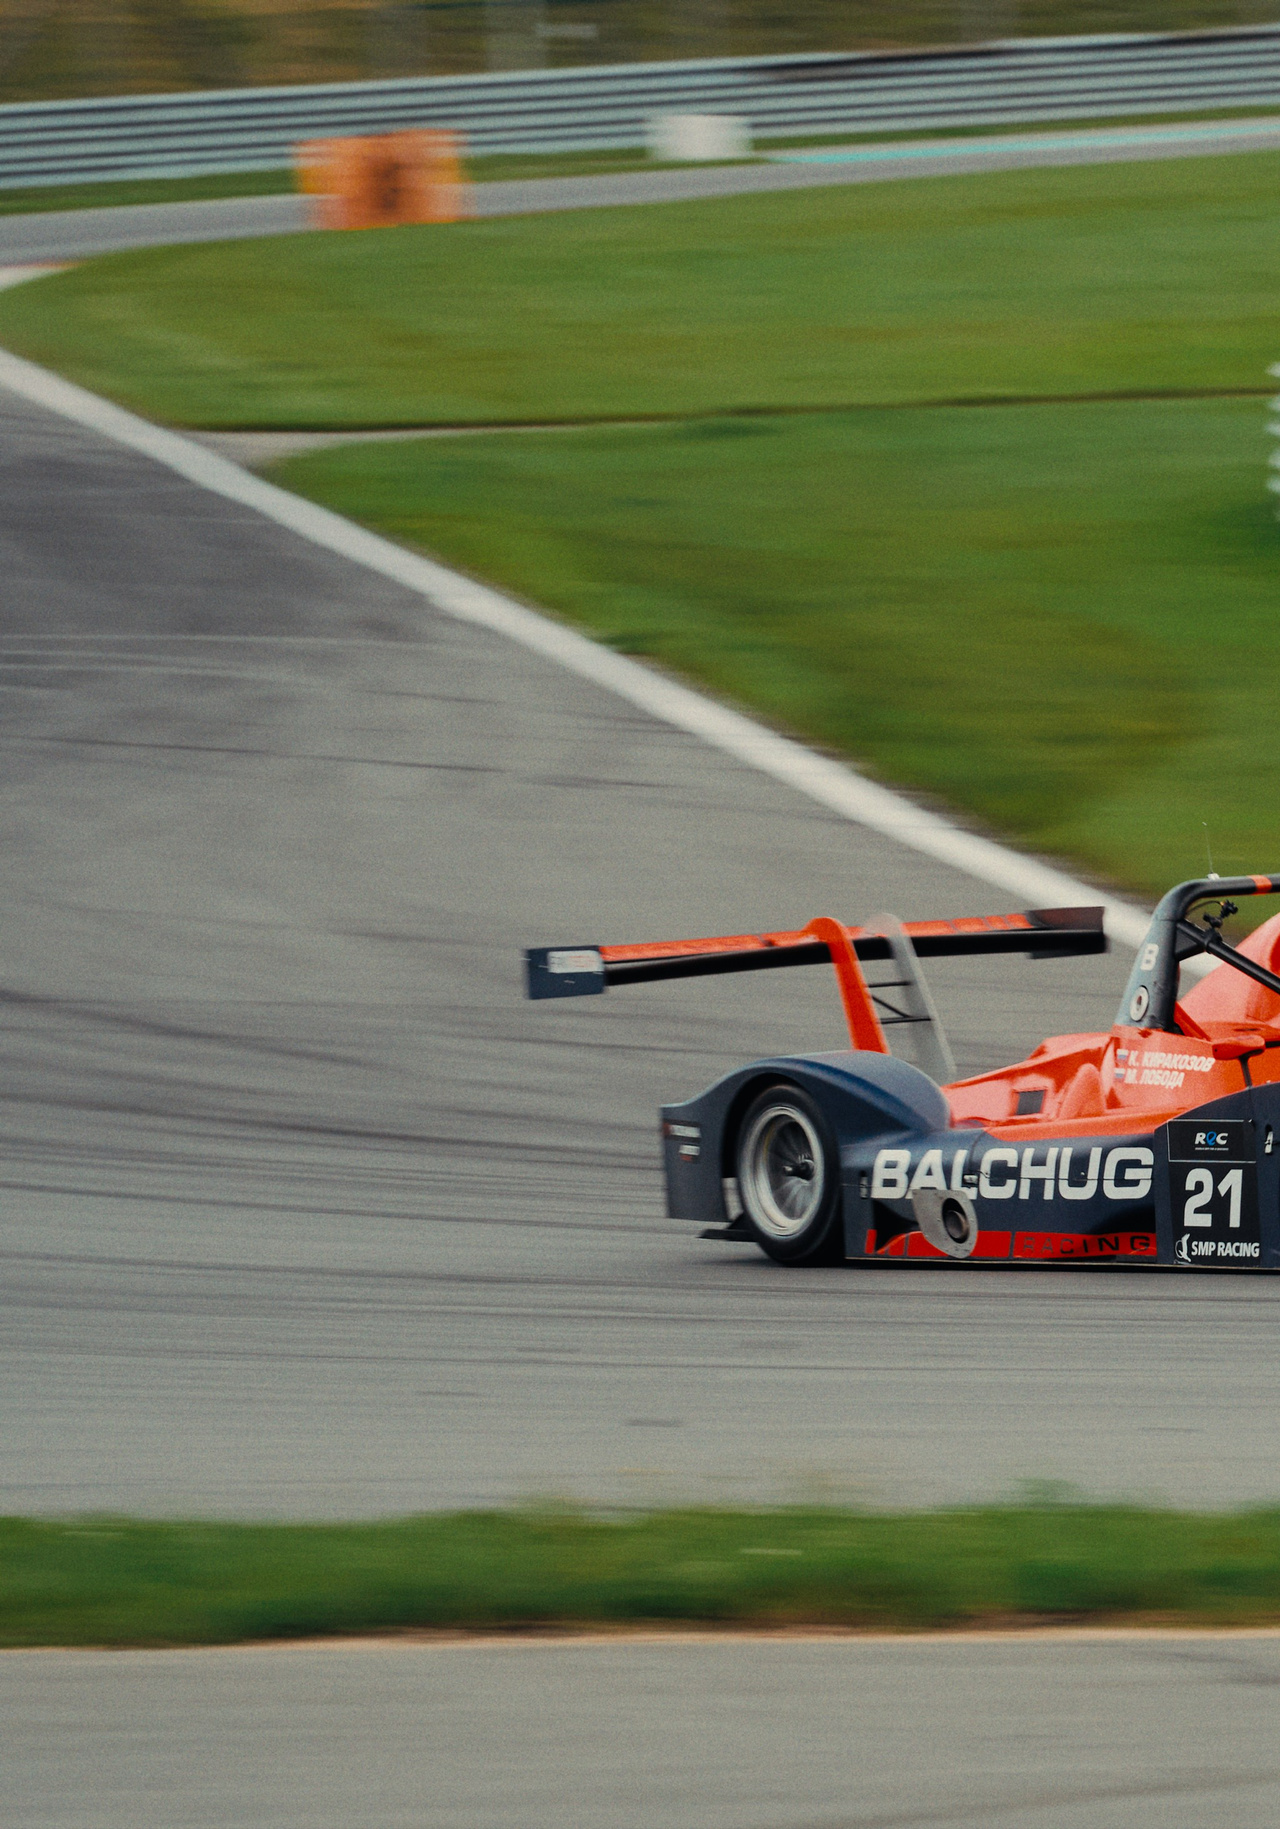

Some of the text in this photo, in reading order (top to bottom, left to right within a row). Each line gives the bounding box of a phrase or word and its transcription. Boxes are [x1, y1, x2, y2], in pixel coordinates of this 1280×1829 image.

[1140, 943, 1159, 971] B
[1142, 1050, 1216, 1073] КИРАКОЗОВ
[1140, 1068, 1185, 1090] ЛОБОДА
[870, 1147, 1155, 1200] BALCHUG
[1183, 1167, 1243, 1228] 21
[1022, 1235, 1151, 1255] RACING
[1191, 1241, 1260, 1258] SMP RACING
